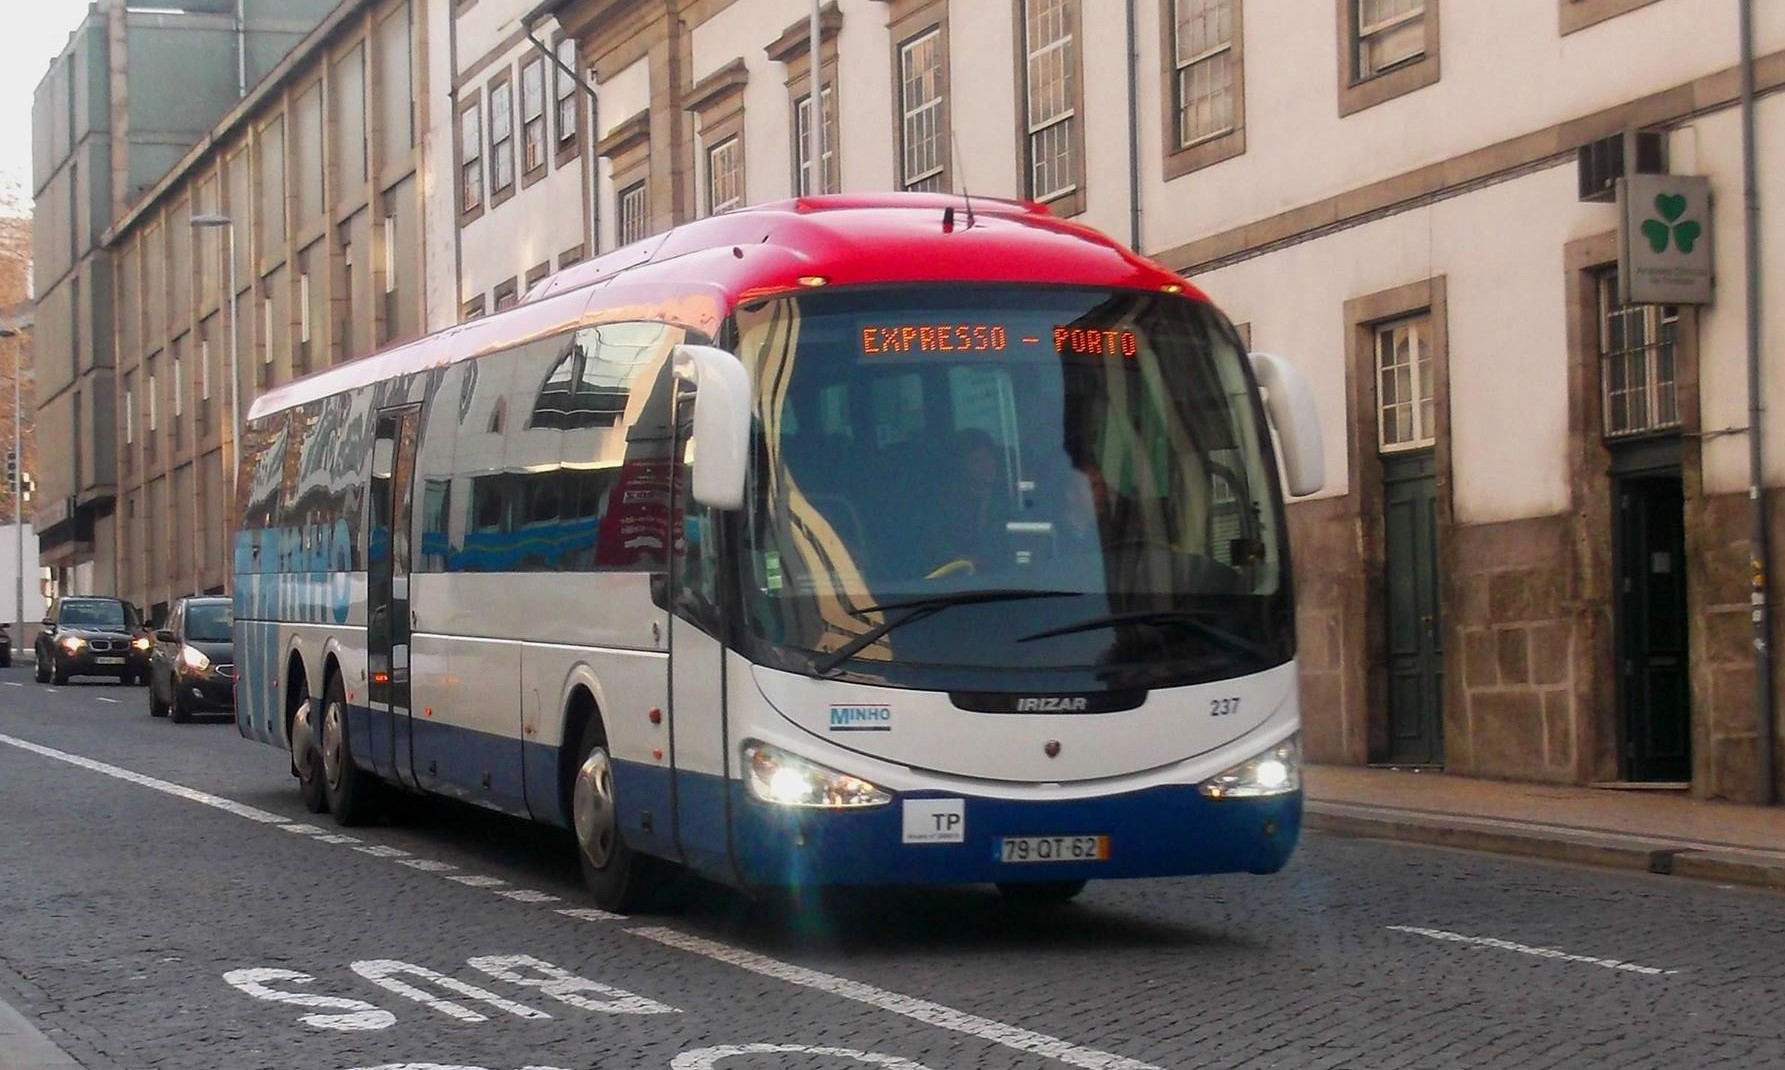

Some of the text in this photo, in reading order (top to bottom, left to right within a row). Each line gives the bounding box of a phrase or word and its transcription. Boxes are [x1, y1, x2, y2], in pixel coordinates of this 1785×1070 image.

[862, 325, 1008, 353] EXPRESSO
[1053, 325, 1137, 356] PORTO
[1017, 697, 1088, 712] IRIZAR
[1210, 697, 1241, 716] 237
[831, 708, 890, 725] MINHO
[931, 813, 960, 831] TP
